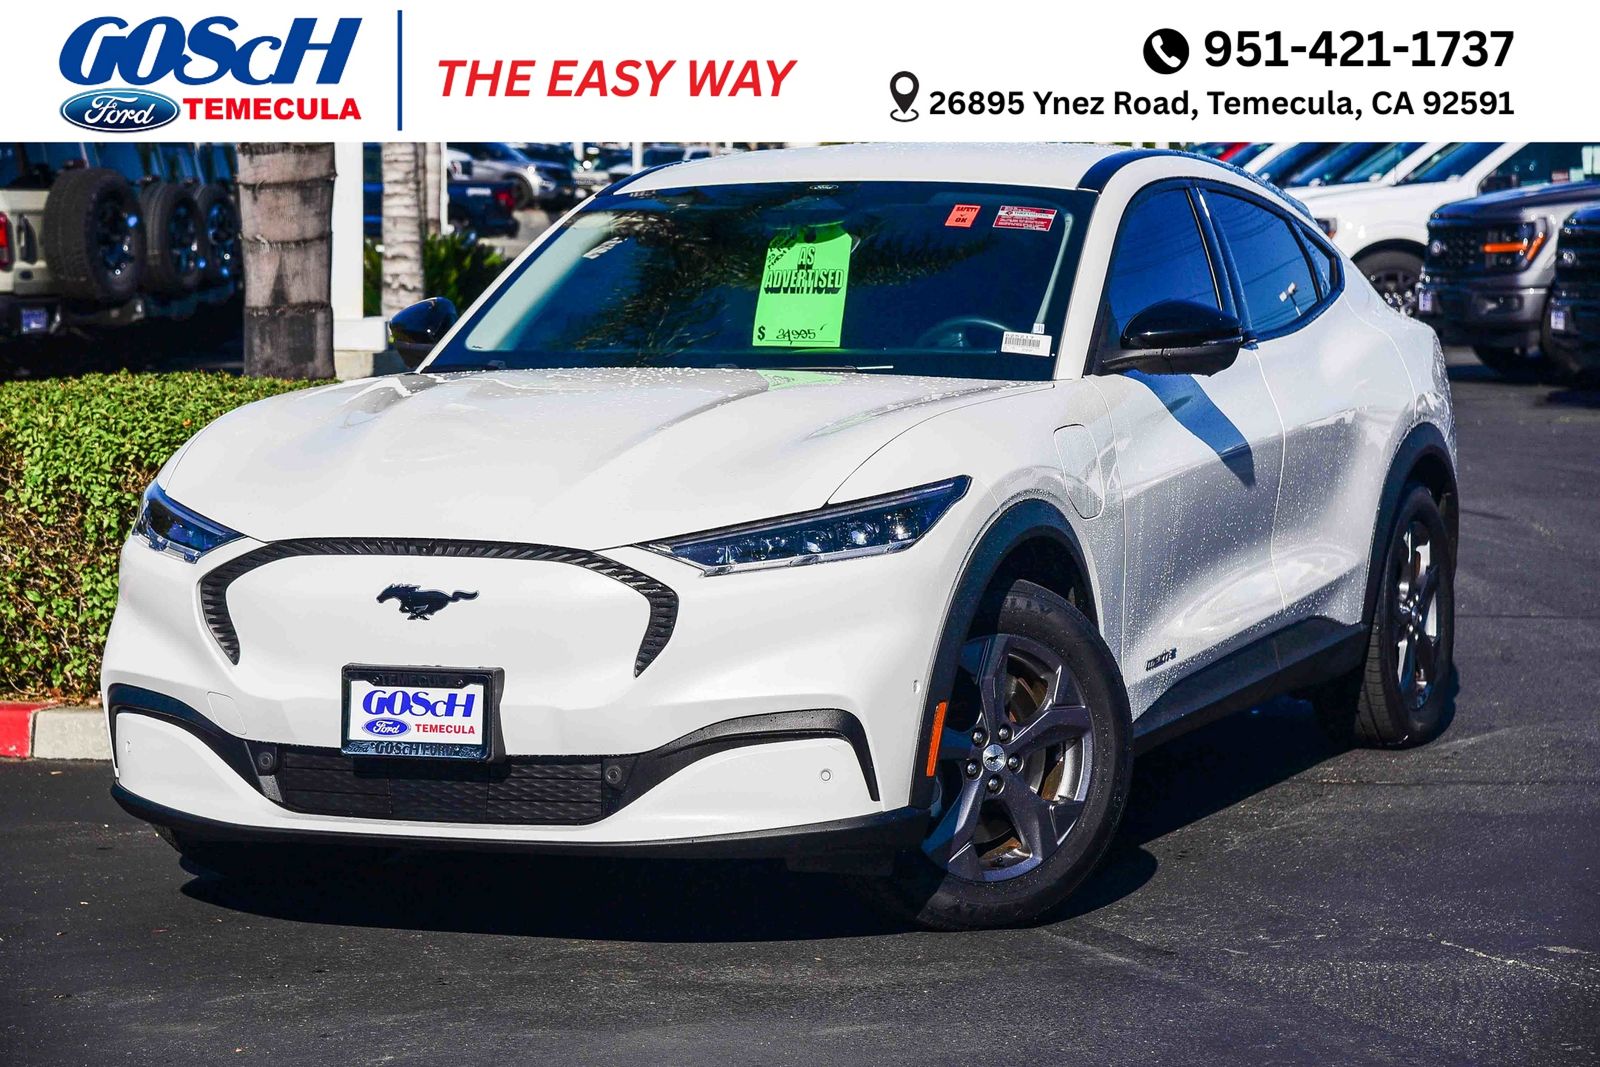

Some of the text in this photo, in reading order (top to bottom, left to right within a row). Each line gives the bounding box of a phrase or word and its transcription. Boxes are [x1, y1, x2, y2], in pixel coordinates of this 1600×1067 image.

[798, 247, 816, 269] AS
[764, 269, 844, 294] ADVERTISED
[757, 325, 766, 341] $
[372, 720, 401, 734] Ford
[415, 723, 476, 735] TEMECULA
